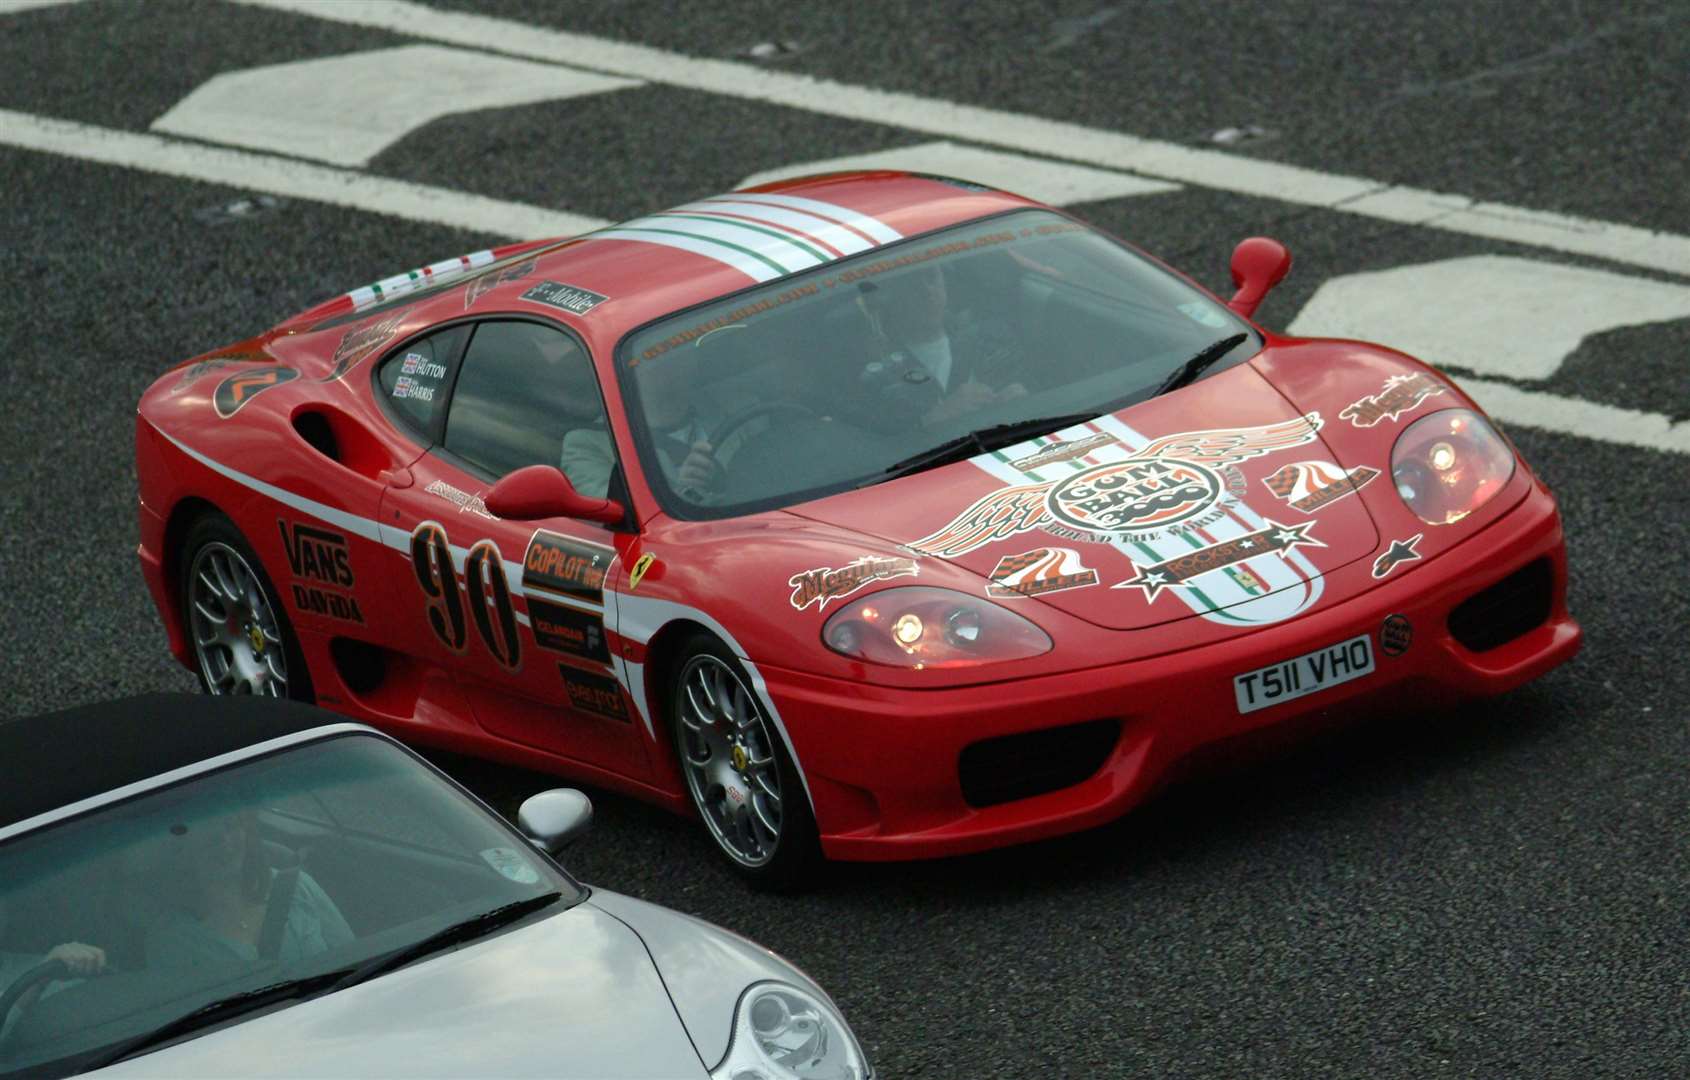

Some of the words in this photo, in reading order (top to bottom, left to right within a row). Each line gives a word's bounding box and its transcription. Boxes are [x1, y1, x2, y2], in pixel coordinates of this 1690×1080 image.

[415, 360, 447, 379] HUTTON
[407, 383, 435, 401] HARRIS
[1058, 461, 1172, 502] GUM
[1075, 474, 1194, 513] BALL
[1097, 486, 1211, 529] 3000
[1119, 531, 1162, 544] THE
[1166, 510, 1227, 536] WORLD
[278, 518, 354, 588] VANS
[1166, 534, 1272, 574] ROCKSTR
[410, 520, 521, 672] 90
[1238, 661, 1300, 705] T511
[1307, 639, 1369, 684] VHO
